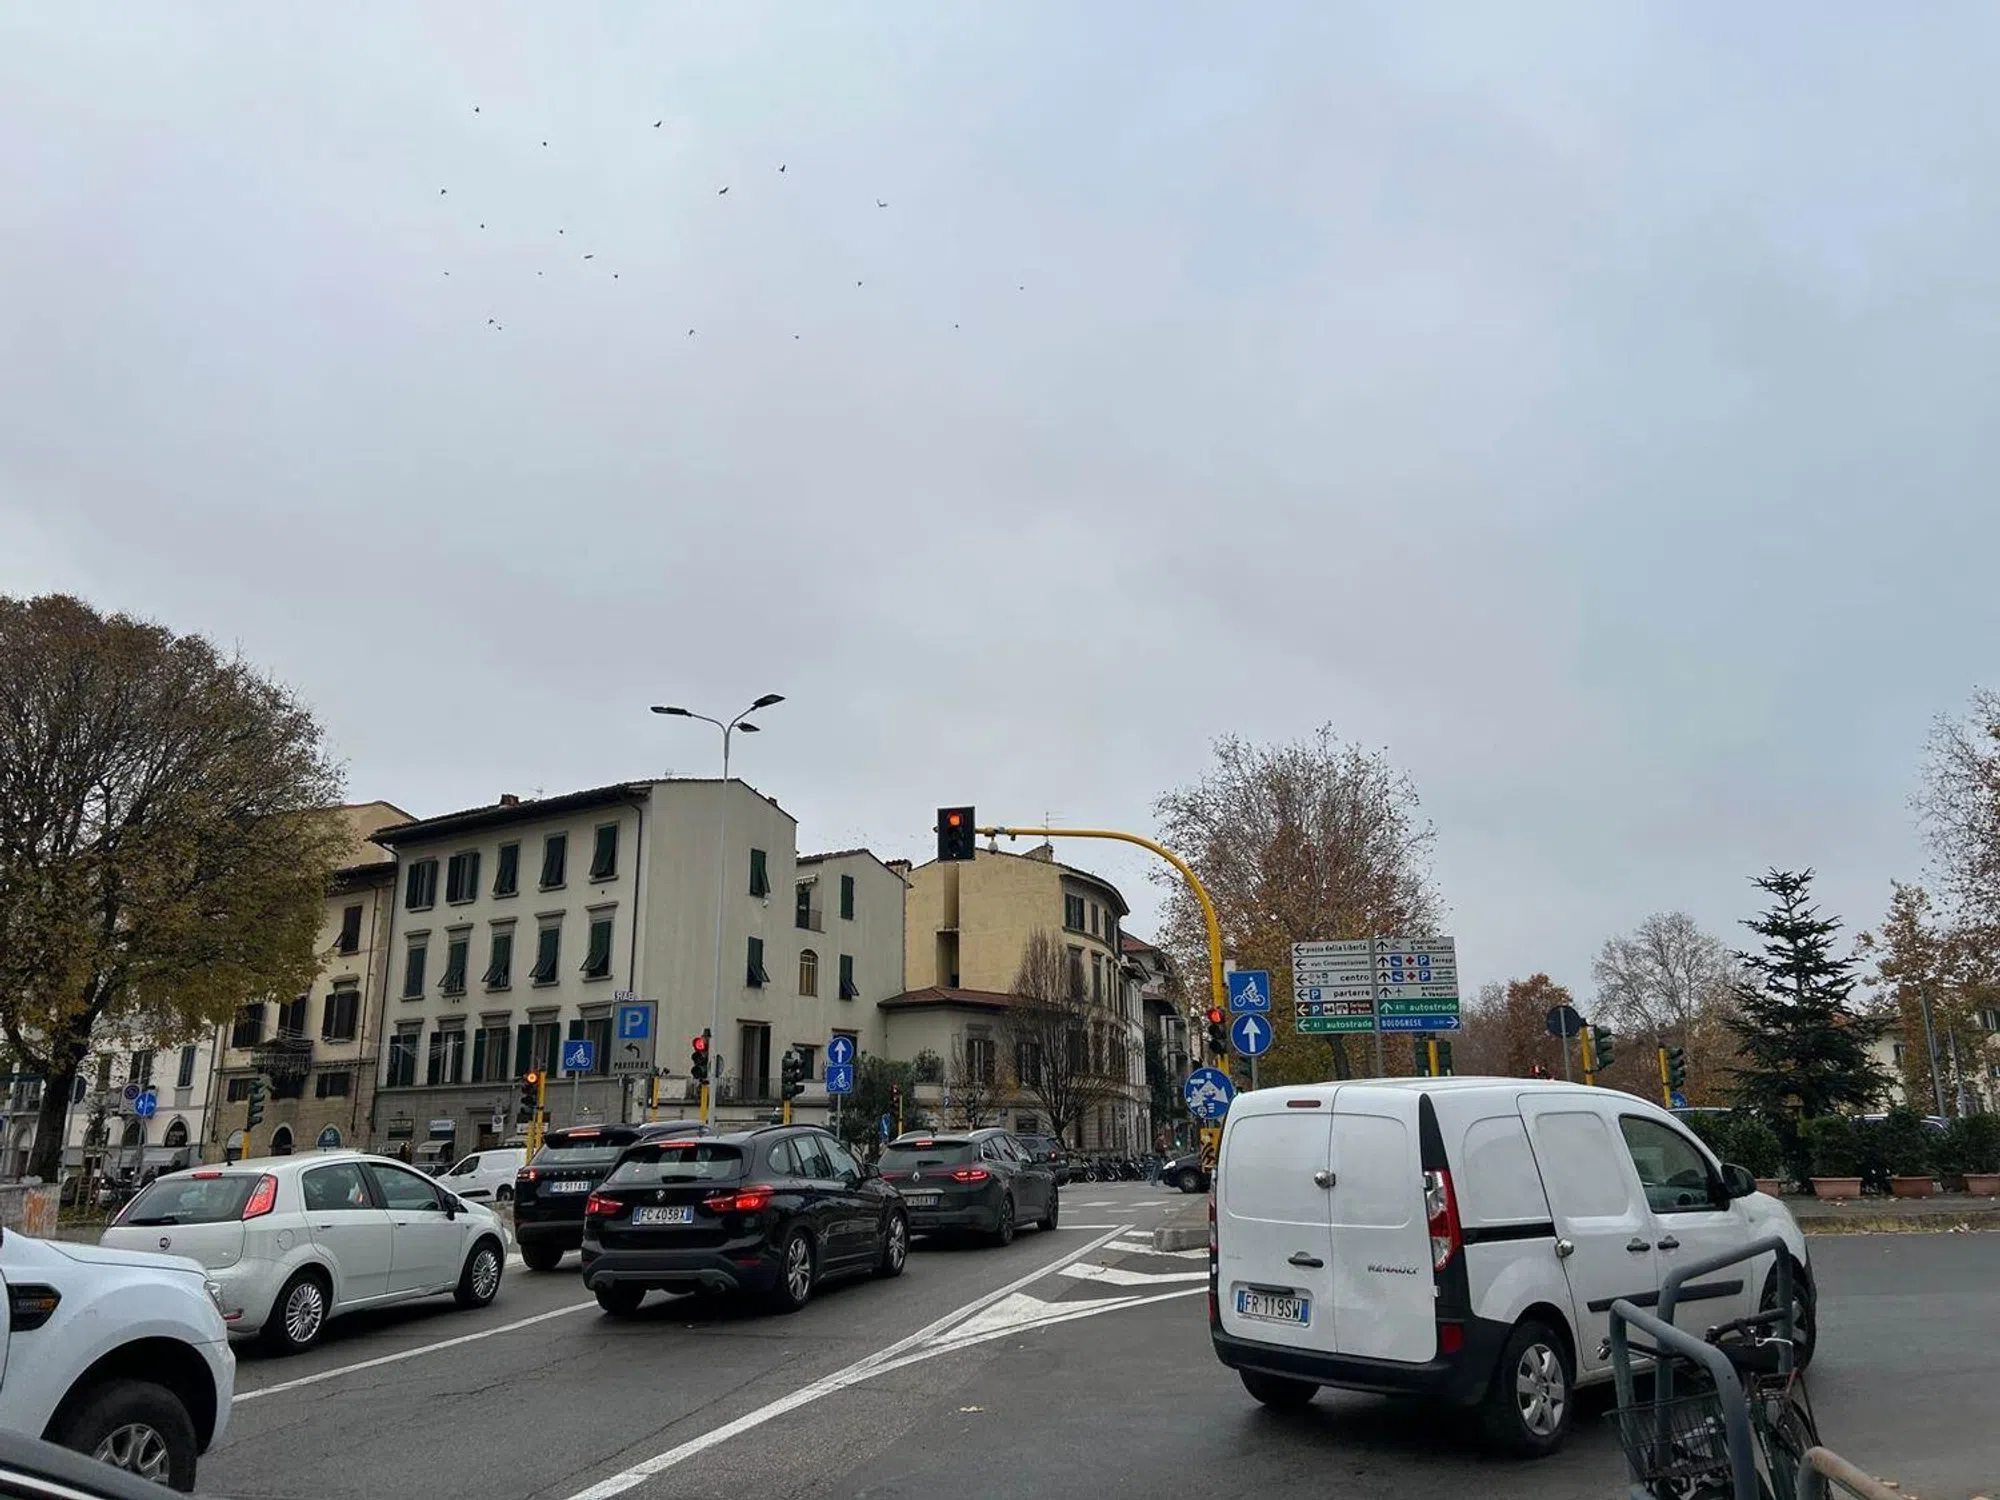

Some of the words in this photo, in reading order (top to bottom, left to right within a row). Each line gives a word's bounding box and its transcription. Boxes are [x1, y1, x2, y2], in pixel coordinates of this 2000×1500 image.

[1339, 974, 1370, 982] centro
[1333, 989, 1371, 998] parterre
[1409, 1003, 1457, 1011] autostrade
[625, 1012, 643, 1035] P
[1326, 1020, 1373, 1029] autostrade
[1264, 1296, 1301, 1319] 119SW
